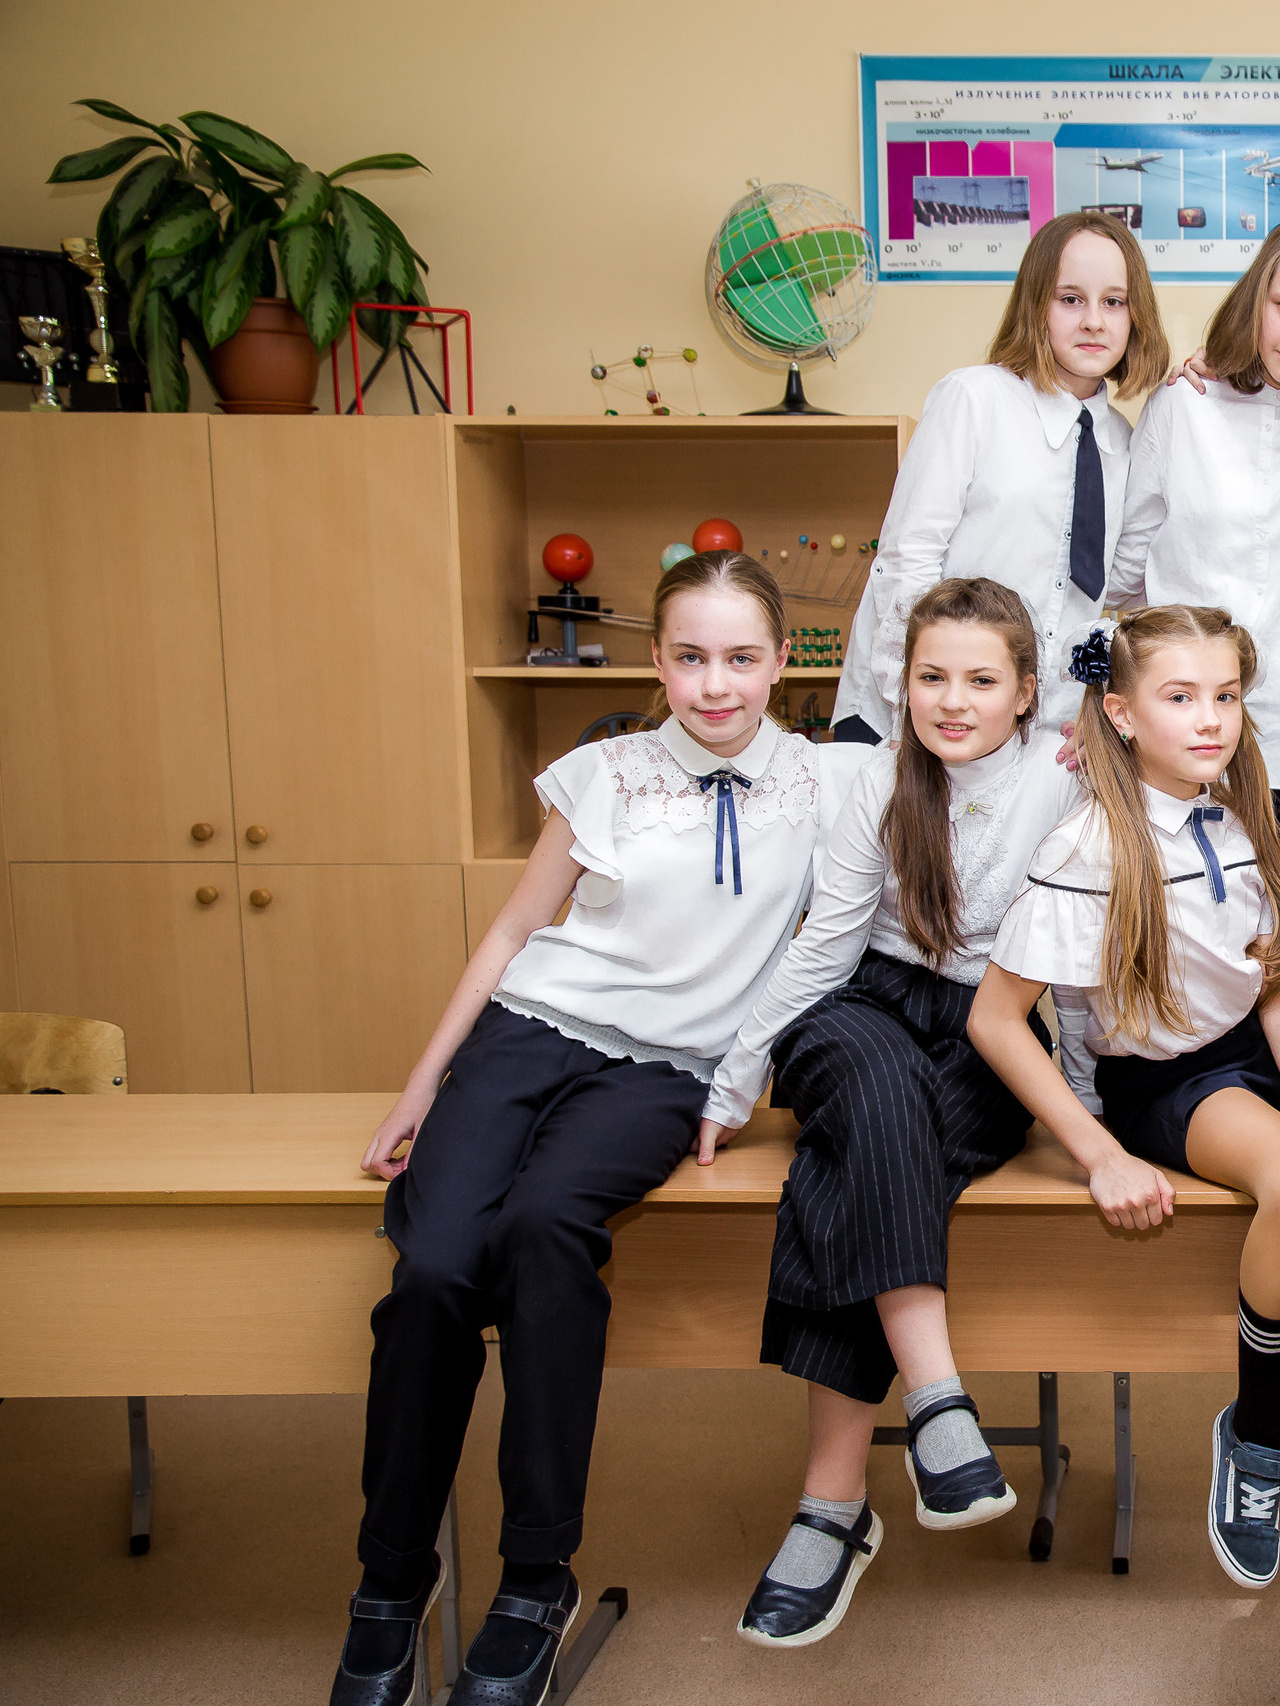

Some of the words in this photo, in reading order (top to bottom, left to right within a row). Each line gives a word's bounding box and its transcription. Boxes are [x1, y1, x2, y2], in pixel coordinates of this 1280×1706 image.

[1108, 64, 1185, 80] ШКАЛА
[954, 90, 1042, 100] ИЗЛУЧЕНИЕ
[1051, 90, 1173, 100] ЭЛЕКТРИЧЕСКИХ
[1182, 90, 1280, 100] ВИБРАТОРОВ
